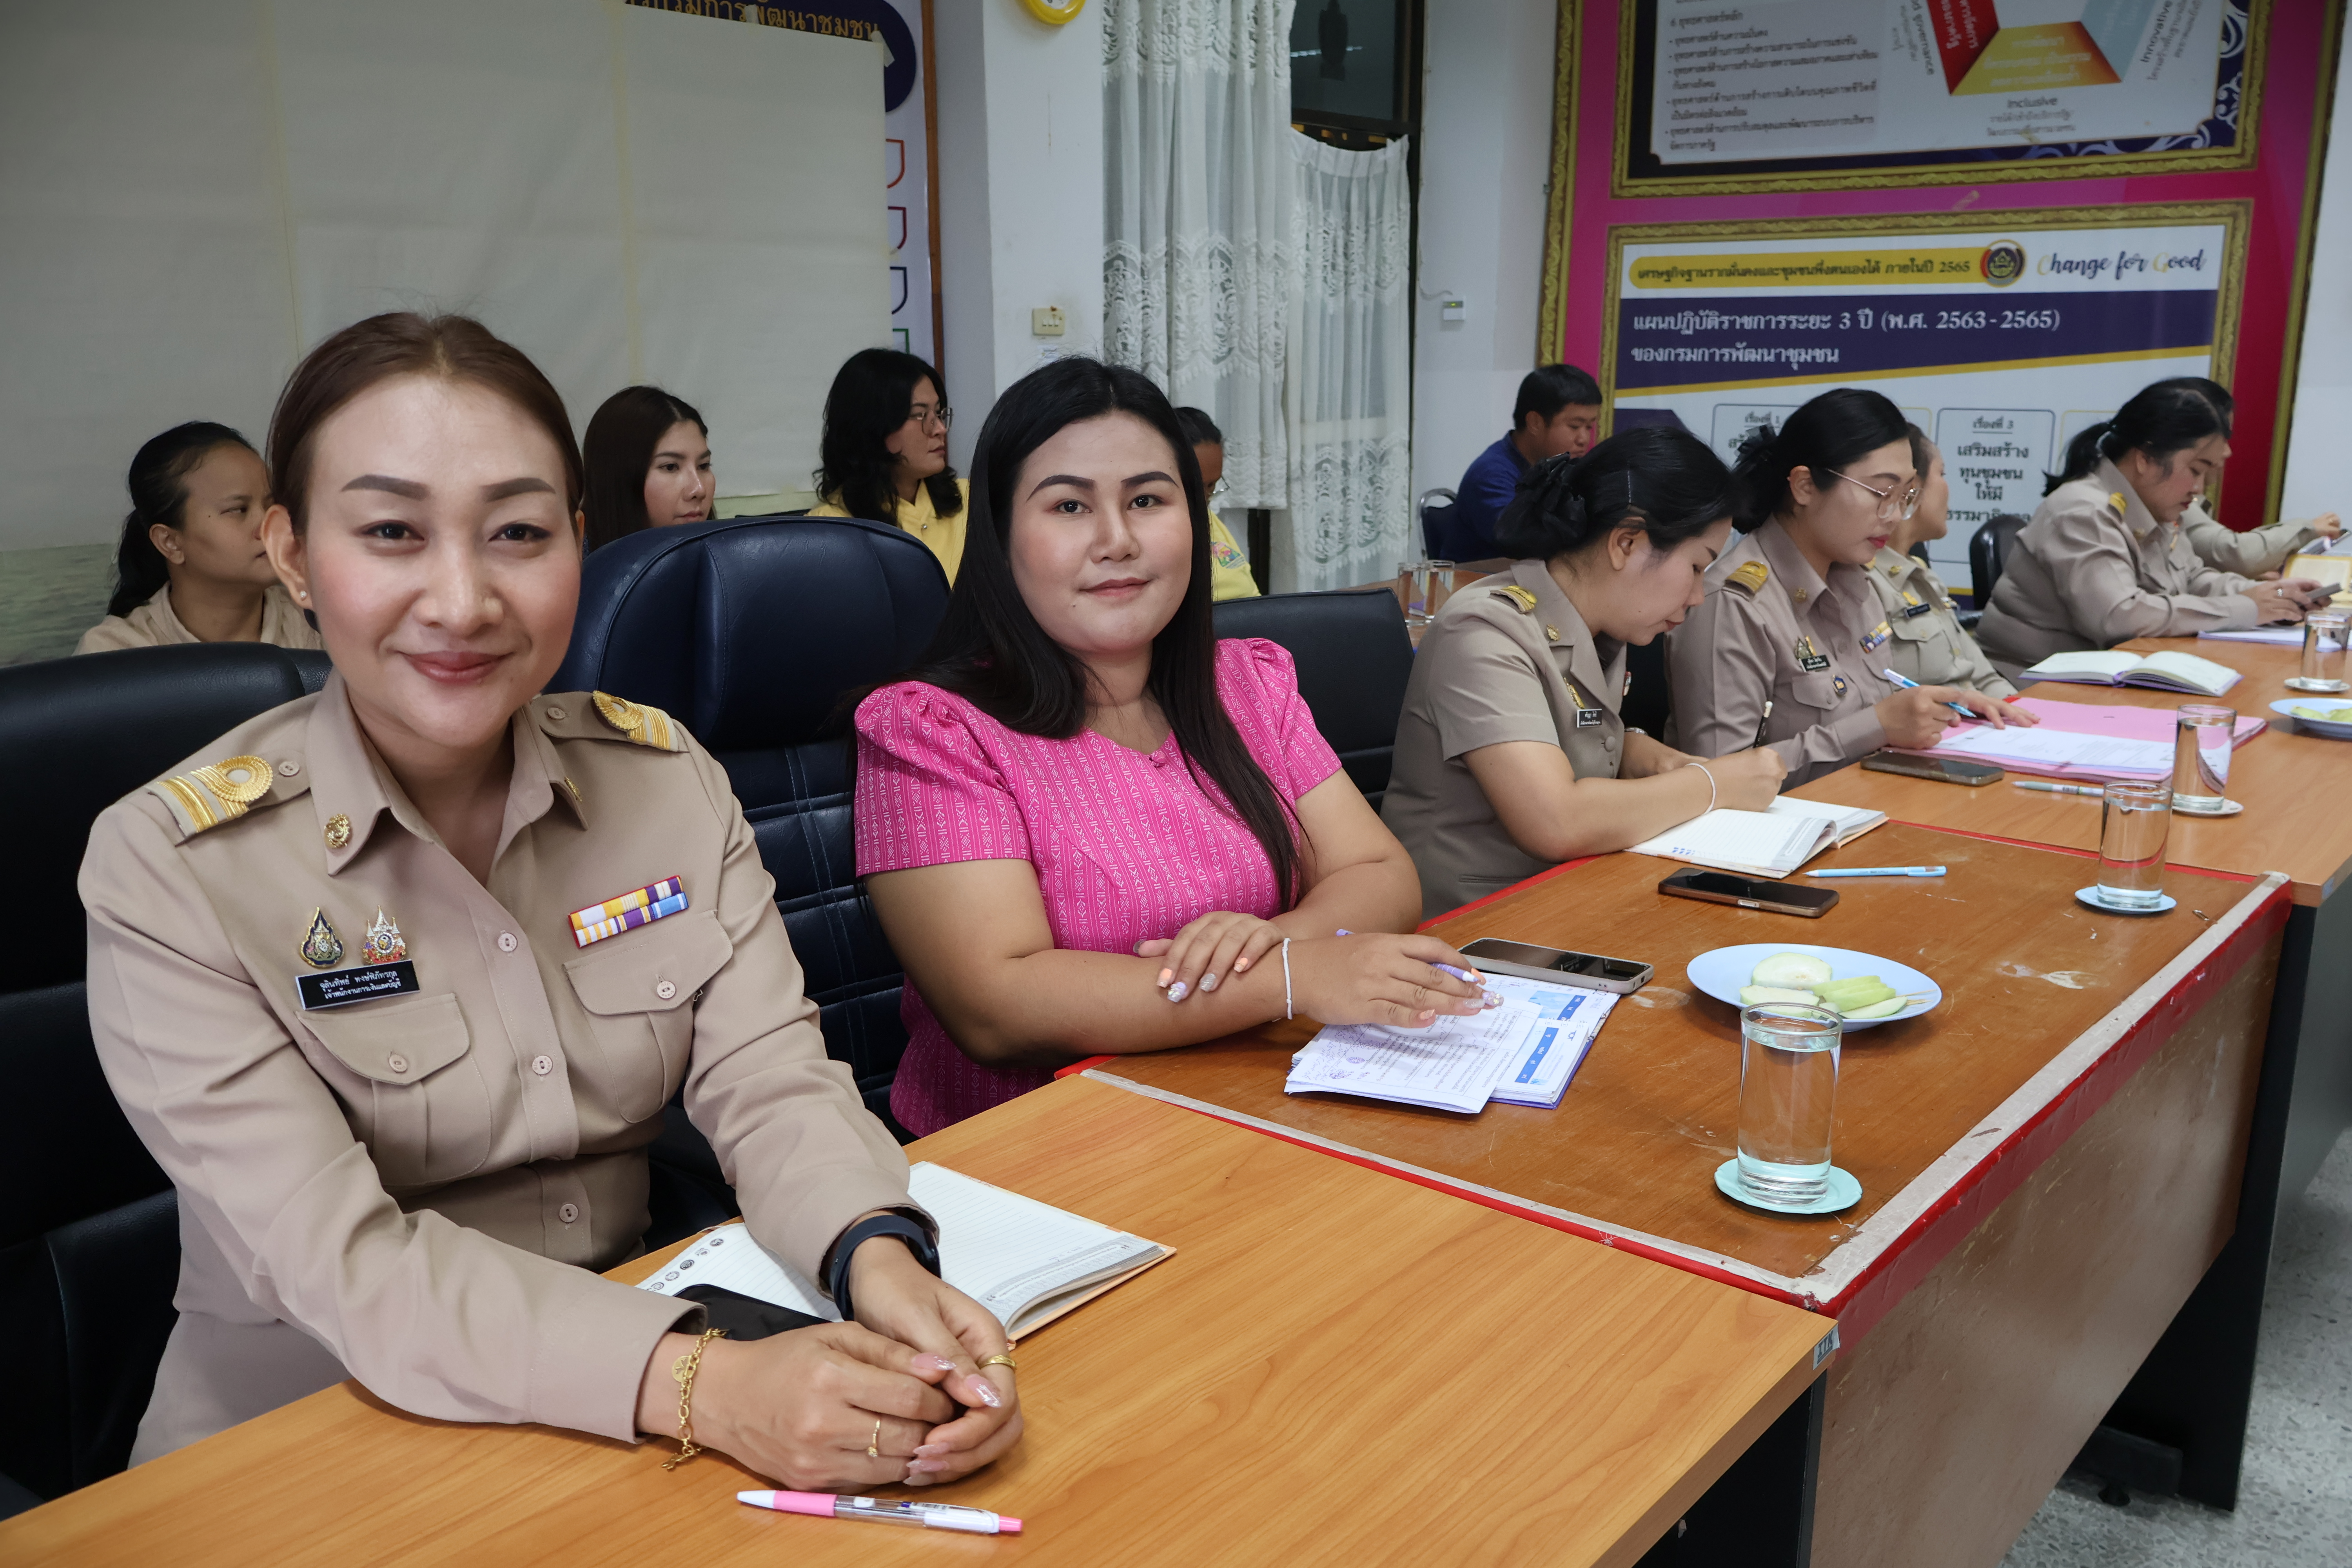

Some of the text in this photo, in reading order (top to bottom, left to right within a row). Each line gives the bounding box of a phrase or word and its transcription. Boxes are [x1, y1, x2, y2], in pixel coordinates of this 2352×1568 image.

[1939, 261, 1970, 273] 2565
[2037, 249, 2205, 280] Change for Good
[1633, 310, 1832, 335] แผนปฏิบัติราชการระยะ
[1838, 312, 1851, 329] 3
[1857, 308, 1873, 329] ปี
[1881, 311, 1927, 332] (พ.ศ.
[1631, 341, 1840, 370] ของกรมการพัฒนาชุมชน
[2007, 420, 2014, 429] 3
[1958, 441, 2029, 458] เสริมสร้าง
[1960, 468, 2023, 484] ทุนชุมชน
[1975, 482, 2003, 500] ให้มี
[1567, 1030, 1577, 1041] TOT
